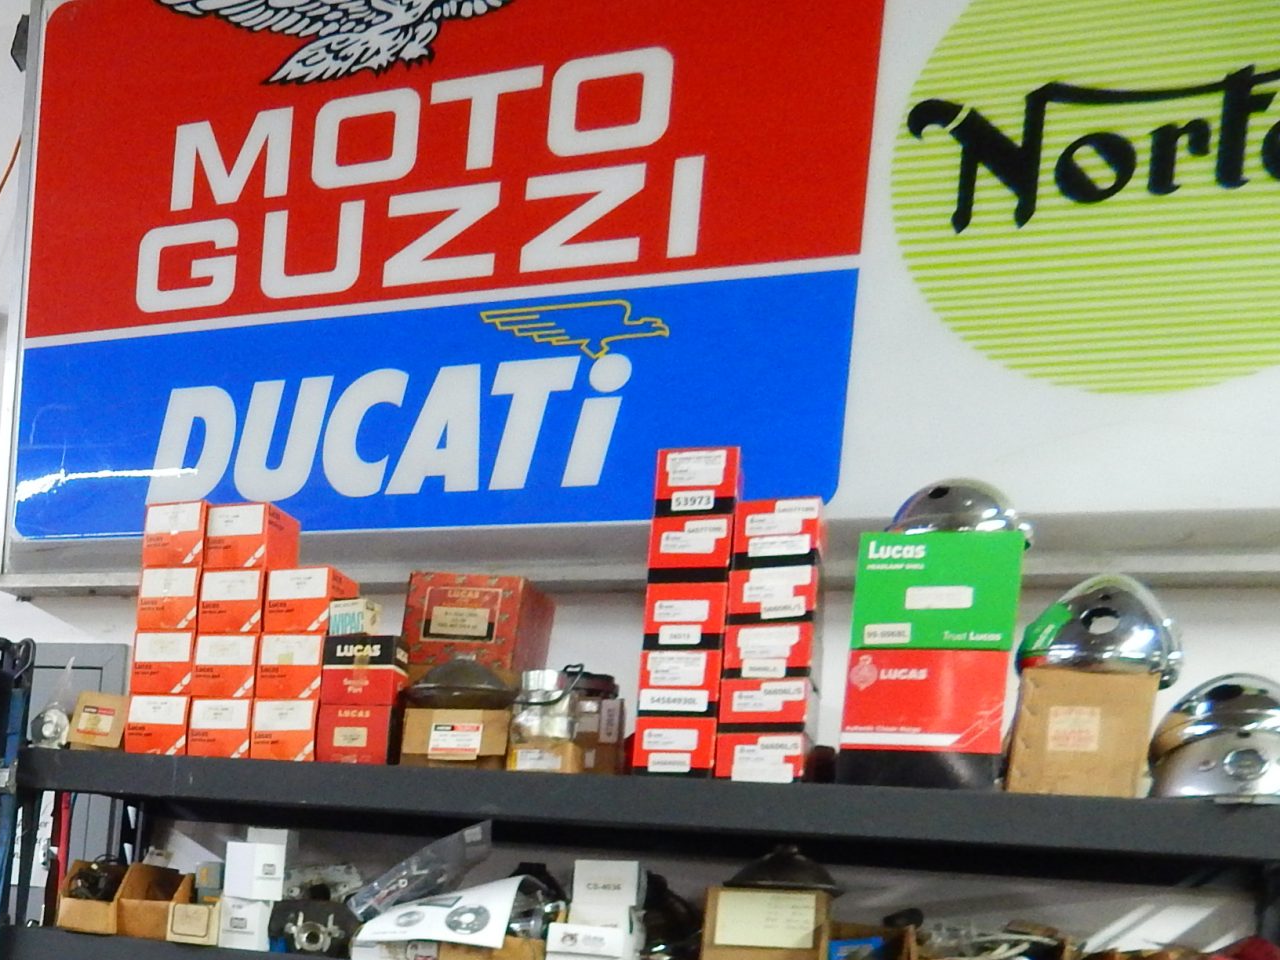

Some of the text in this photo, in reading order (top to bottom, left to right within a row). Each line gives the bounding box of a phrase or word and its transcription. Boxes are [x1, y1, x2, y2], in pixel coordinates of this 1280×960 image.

[170, 46, 674, 211] MOTO
[907, 64, 1280, 234] Nort
[135, 155, 705, 314] GUZZI
[675, 496, 712, 507] 53973
[868, 540, 927, 559] Lucas
[943, 631, 1002, 641] Trust Lucas
[336, 644, 381, 657] LUCAS
[879, 668, 928, 680] LUCAS
[338, 709, 370, 718] LUCAS
